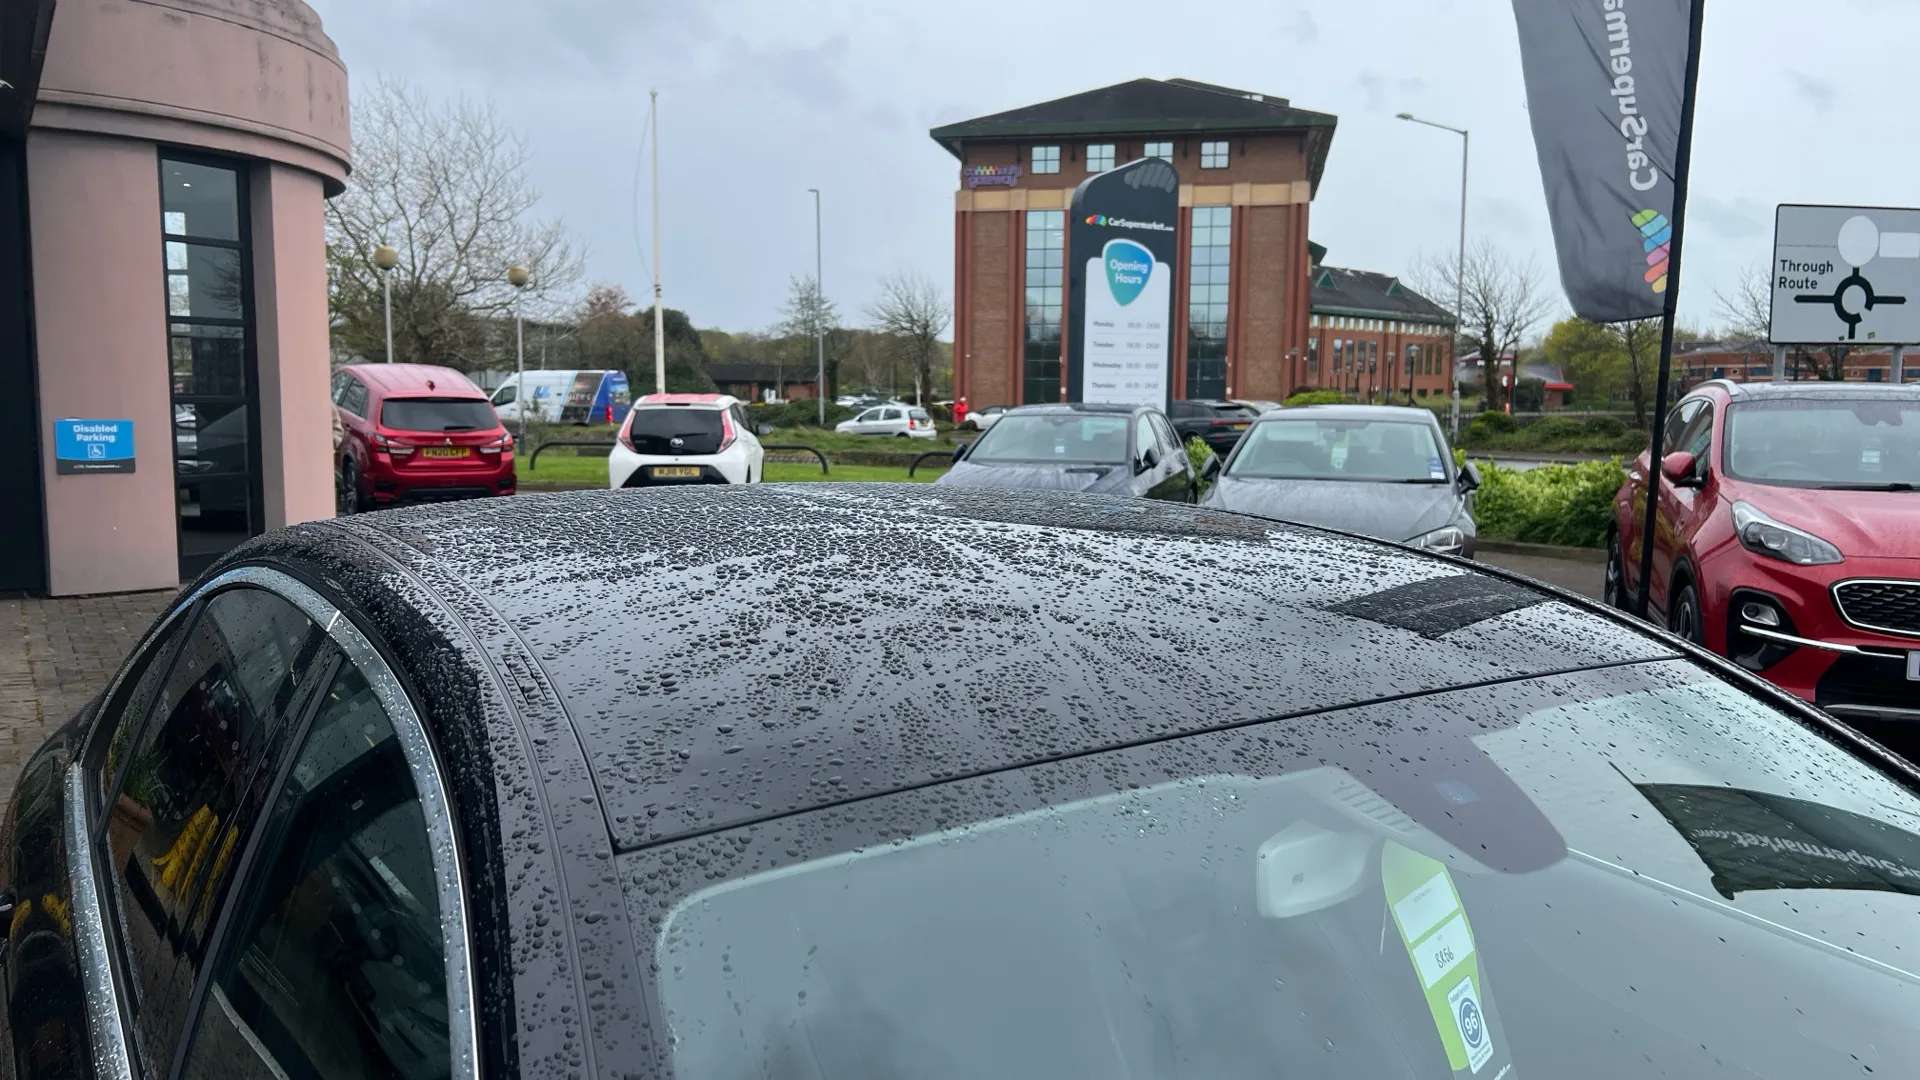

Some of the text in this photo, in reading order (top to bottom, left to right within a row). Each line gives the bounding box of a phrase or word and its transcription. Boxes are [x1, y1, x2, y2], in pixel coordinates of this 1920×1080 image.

[1110, 259, 1148, 274] Opening
[1780, 259, 1833, 275] Through
[1115, 273, 1143, 284] Hours
[1779, 276, 1818, 289] Route
[73, 424, 118, 433] Disabled
[76, 433, 116, 443] Parking
